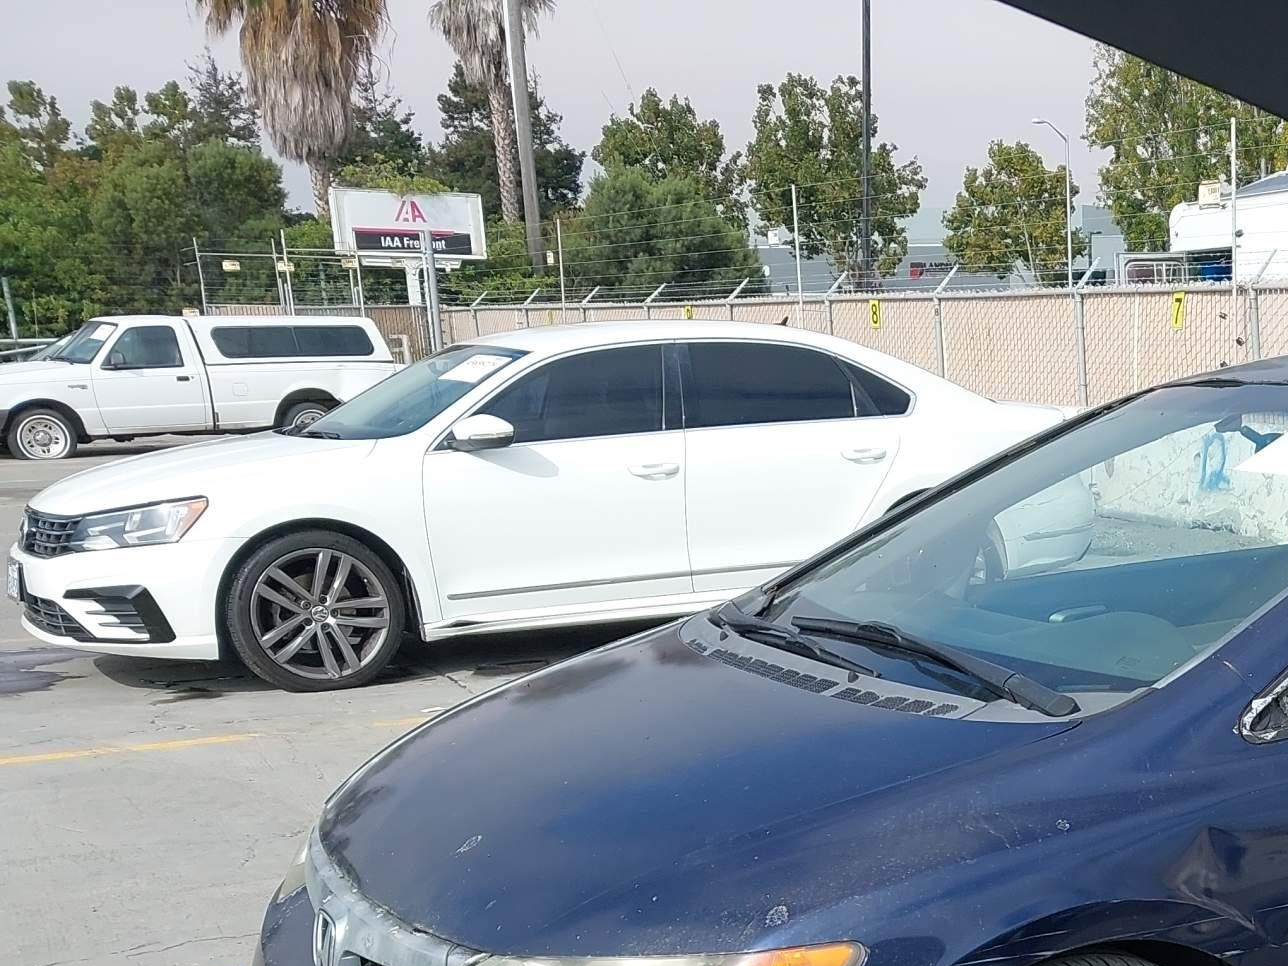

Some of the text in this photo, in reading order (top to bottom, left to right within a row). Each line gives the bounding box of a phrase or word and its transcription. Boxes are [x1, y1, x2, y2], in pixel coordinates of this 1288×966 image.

[380, 235, 446, 250] IAA Frent
[871, 303, 879, 325] 8
[1174, 297, 1183, 325] 7
